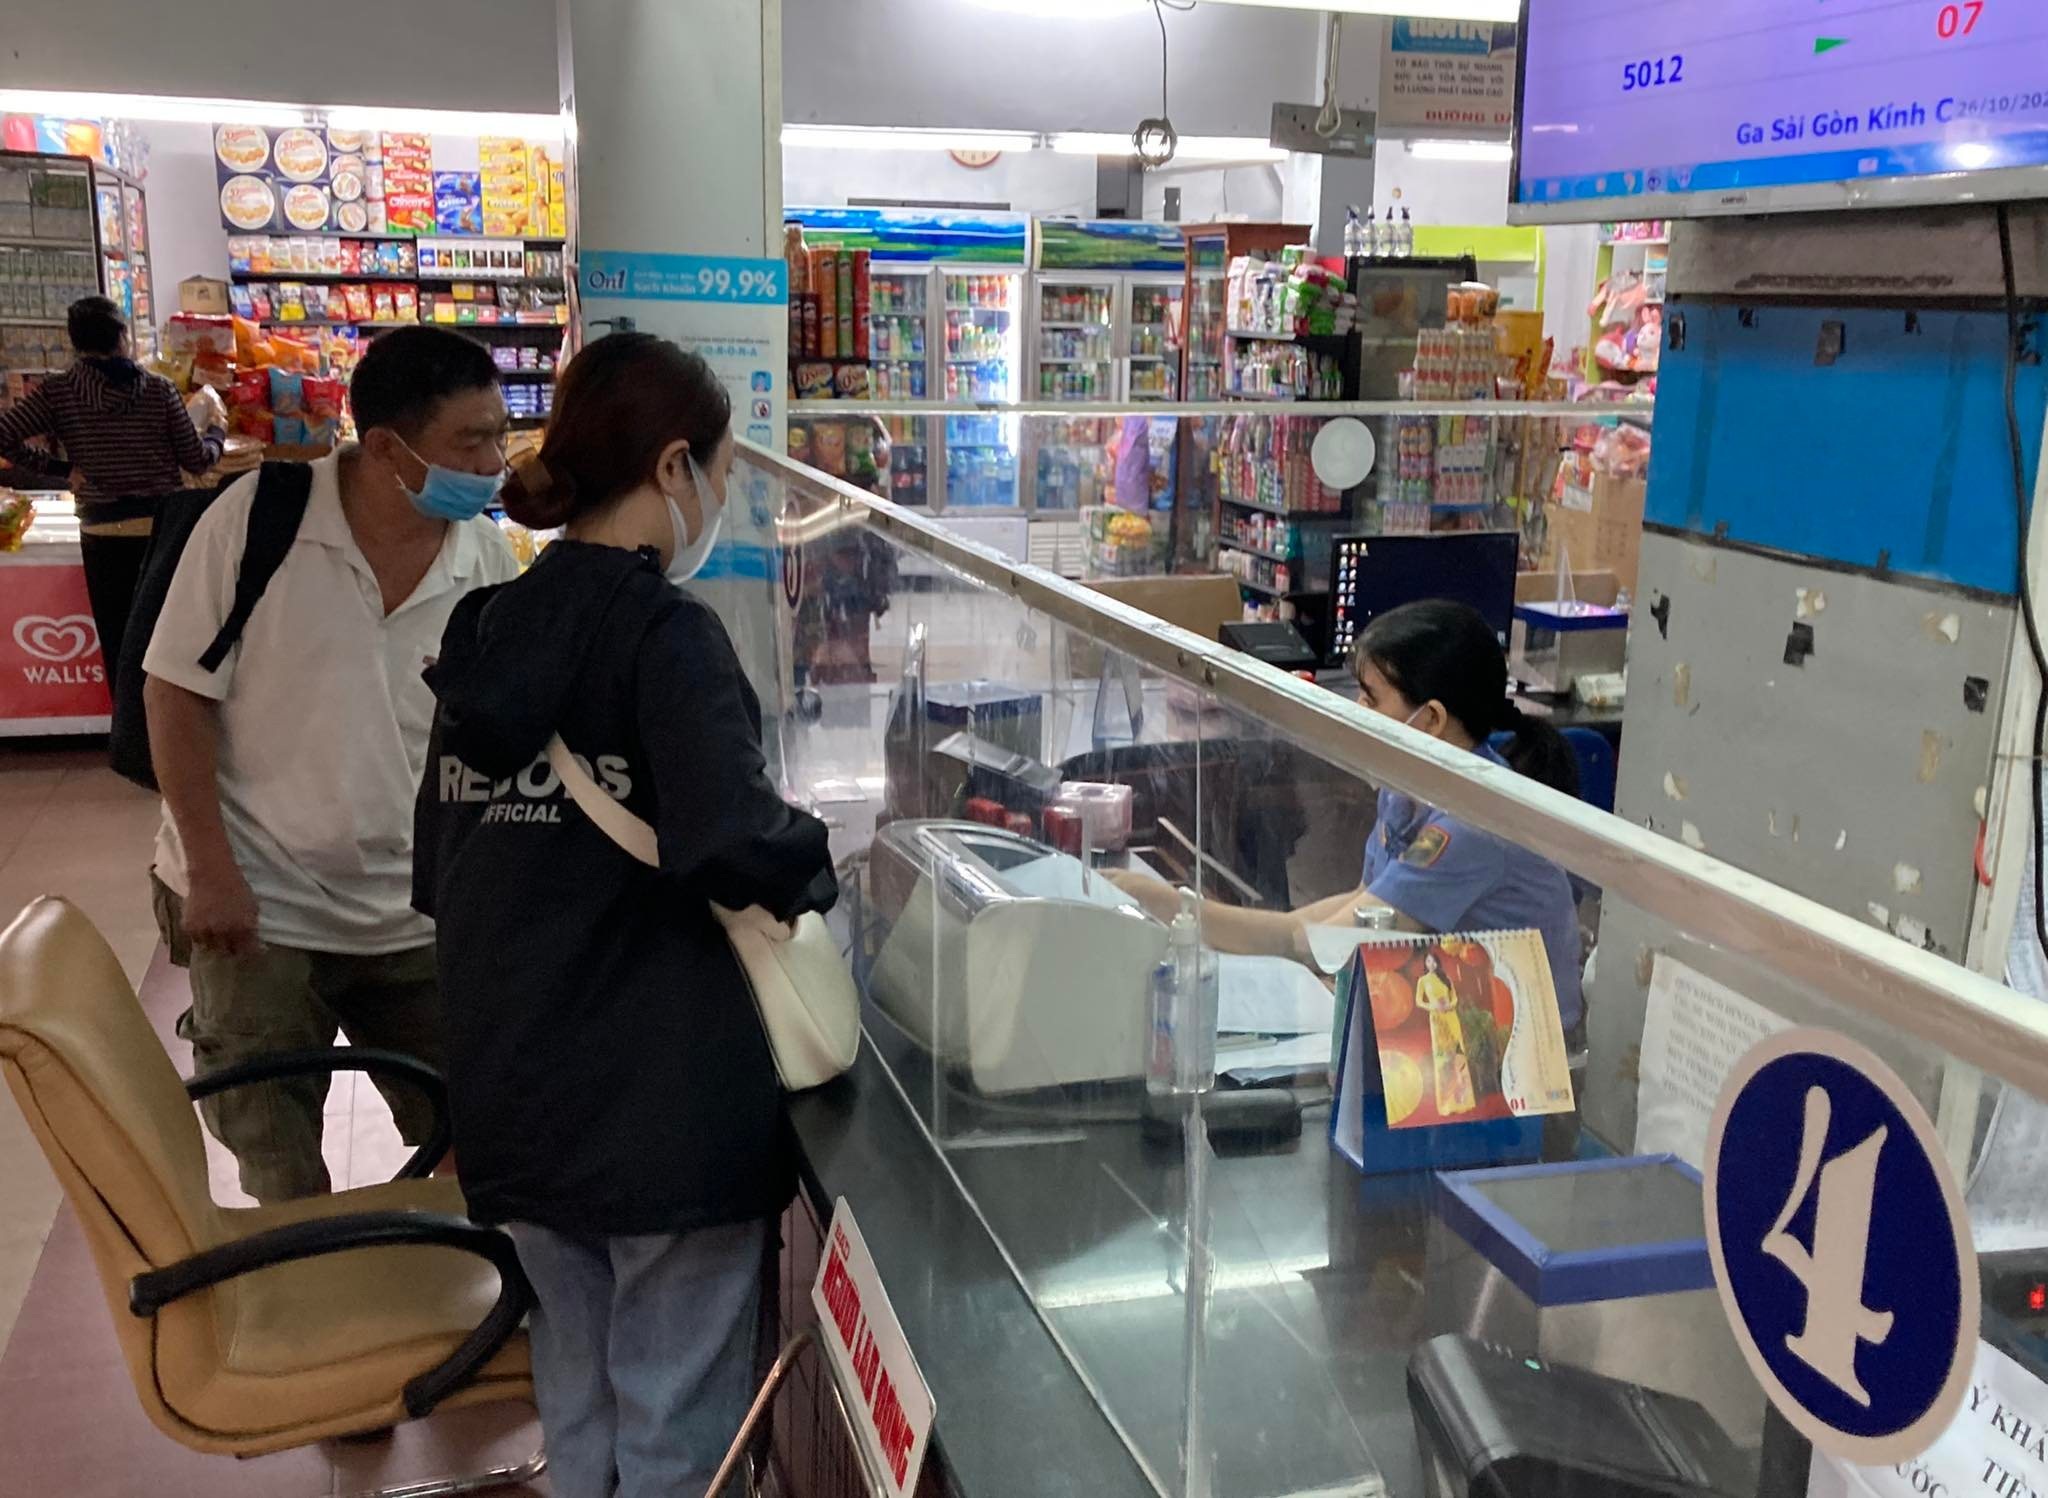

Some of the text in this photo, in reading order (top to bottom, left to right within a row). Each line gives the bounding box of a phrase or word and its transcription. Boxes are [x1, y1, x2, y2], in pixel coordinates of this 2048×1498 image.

[1937, 1, 1984, 38] 07
[1622, 55, 1683, 91] 5012
[1736, 122, 1764, 145] Ga
[1811, 109, 1859, 137] Gòn
[1867, 102, 1925, 132] Kính
[587, 268, 628, 292] On1
[698, 266, 777, 300] 99,9%
[23, 664, 104, 685] WALL'S
[439, 752, 632, 802] REOS
[1761, 1084, 1895, 1408] 4
